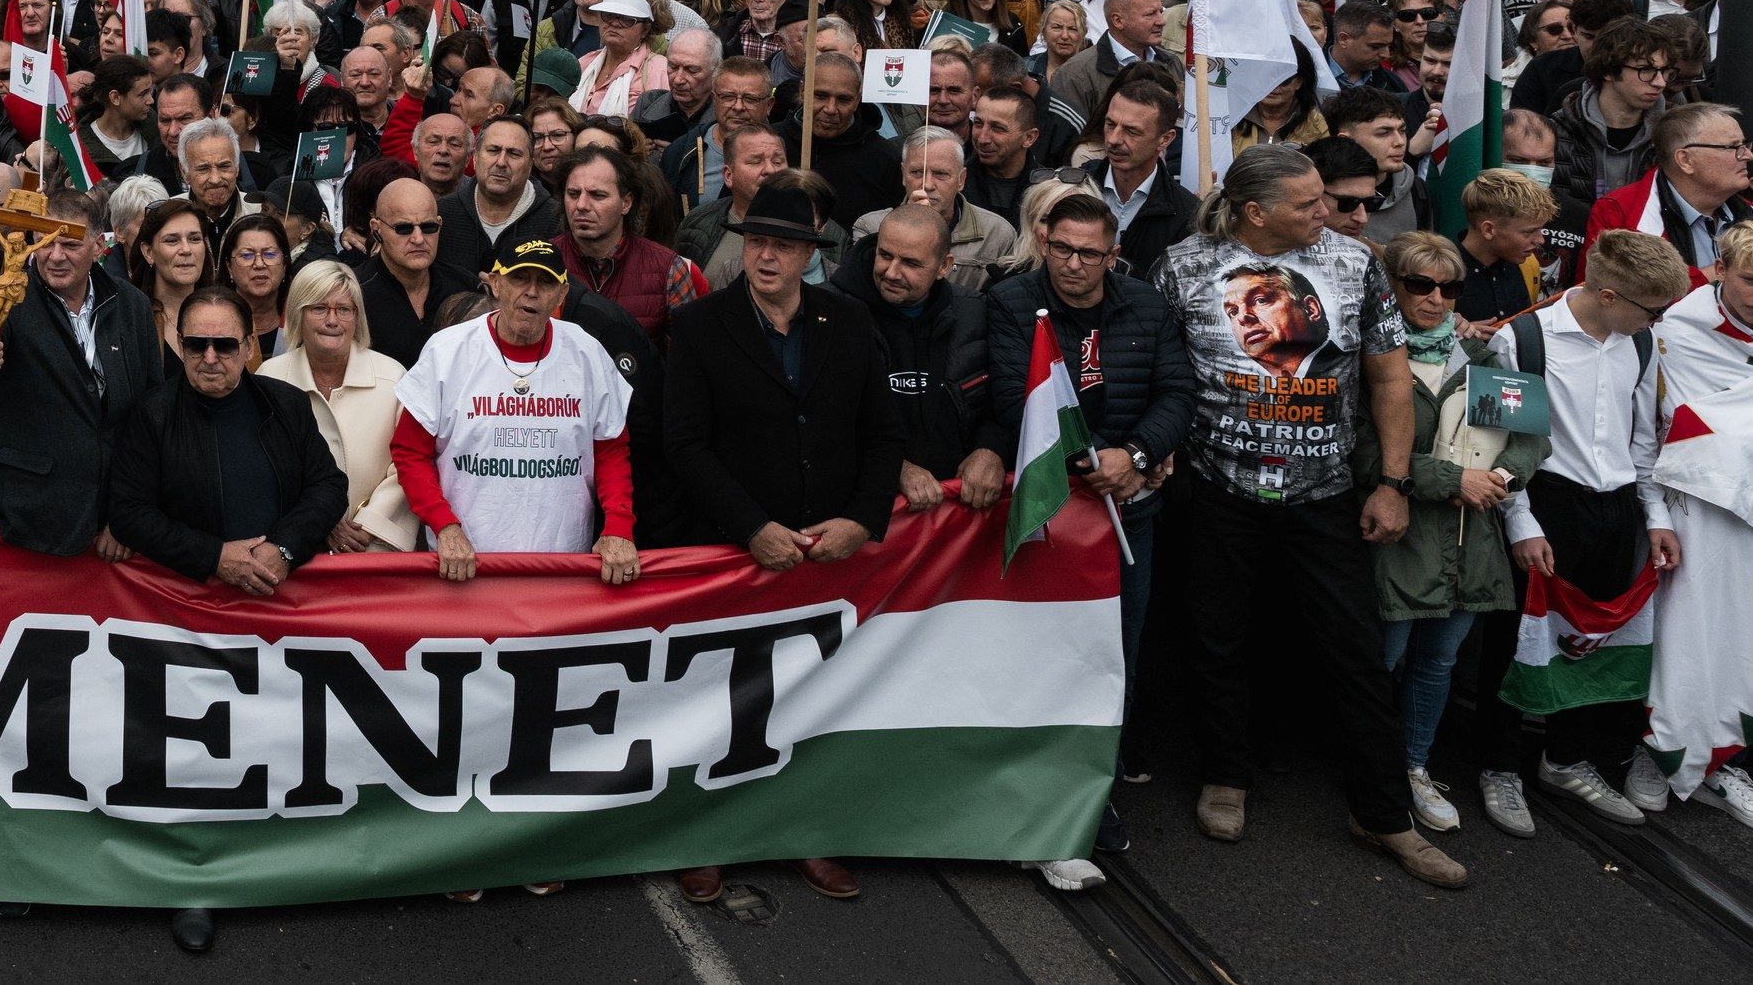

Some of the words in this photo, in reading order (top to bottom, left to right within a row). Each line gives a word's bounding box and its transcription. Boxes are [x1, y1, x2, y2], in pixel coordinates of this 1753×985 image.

[1551, 237, 1575, 248] FOG
[1225, 370, 1260, 394] THE
[1264, 376, 1339, 396] LEADER
[1277, 395, 1292, 404] OF
[1248, 402, 1324, 423] EUROPE
[494, 426, 559, 449] HELYETT
[1219, 415, 1336, 441] PATRIOT
[1209, 429, 1340, 458] PEACEMAKER
